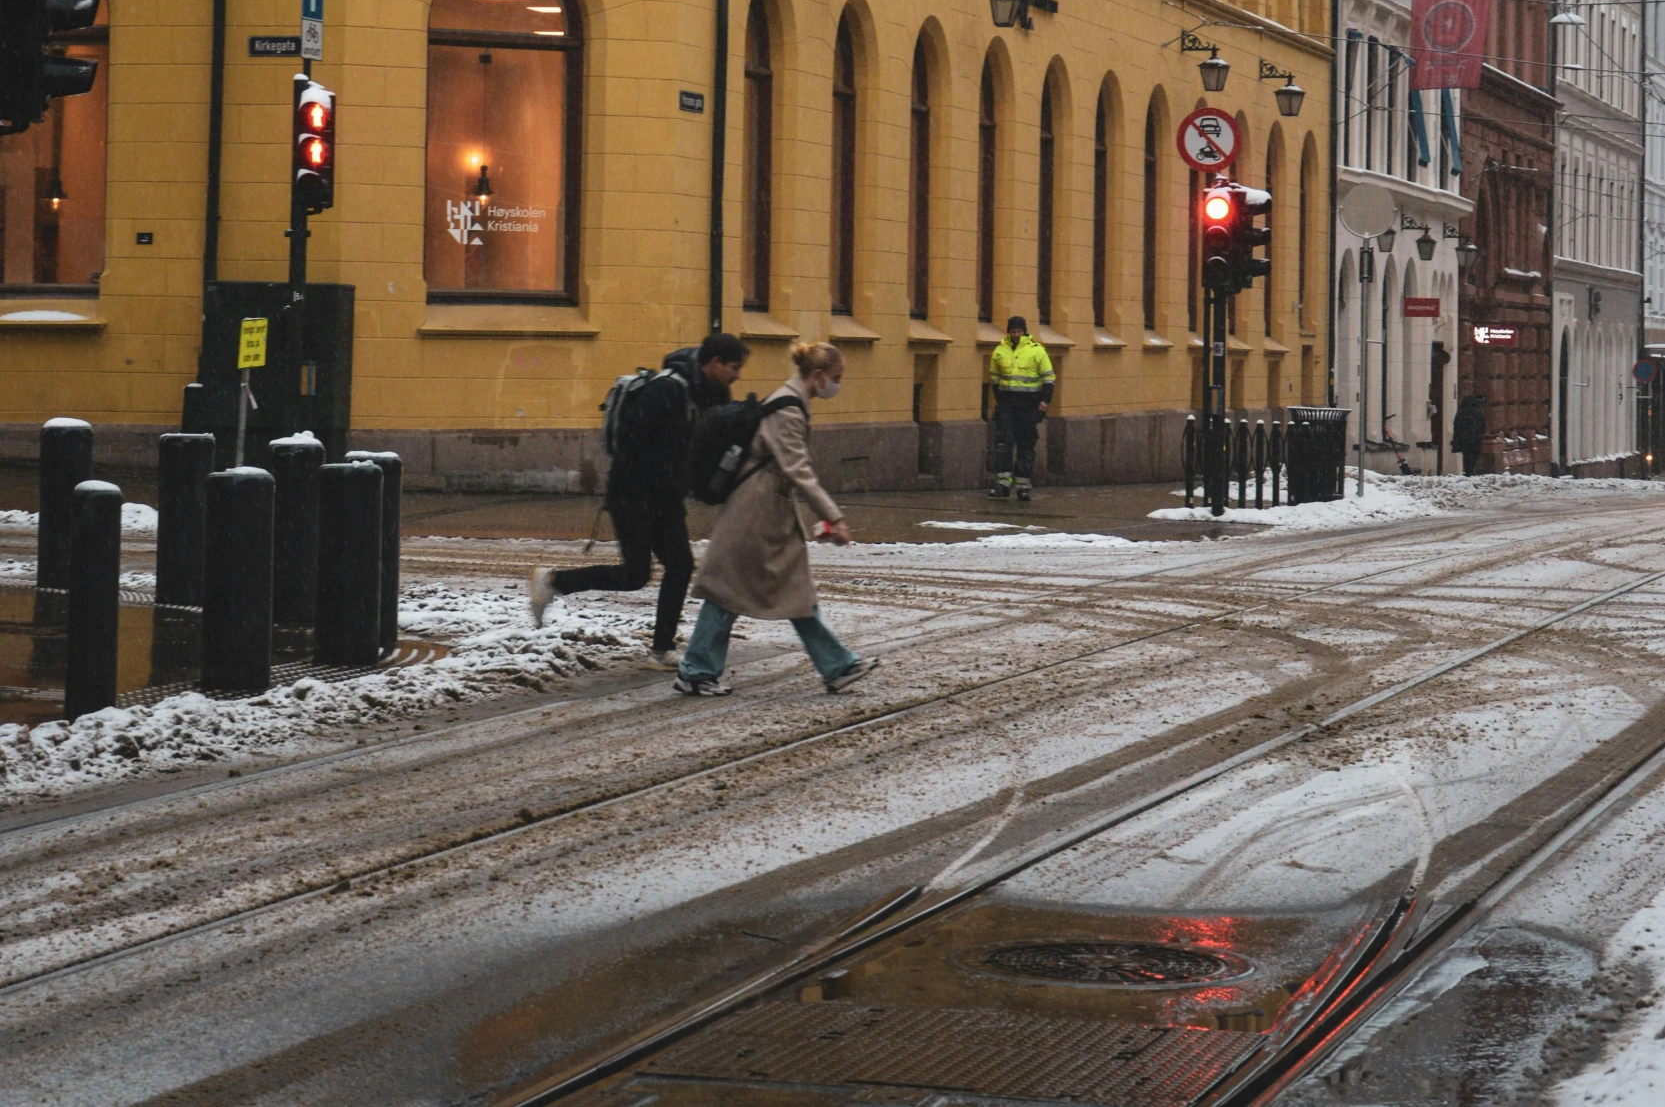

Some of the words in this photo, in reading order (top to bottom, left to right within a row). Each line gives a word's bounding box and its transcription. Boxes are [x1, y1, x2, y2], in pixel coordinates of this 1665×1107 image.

[254, 40, 296, 53] Kirkegata
[487, 206, 546, 219] Høyskolen
[487, 221, 539, 232] Kristiania
